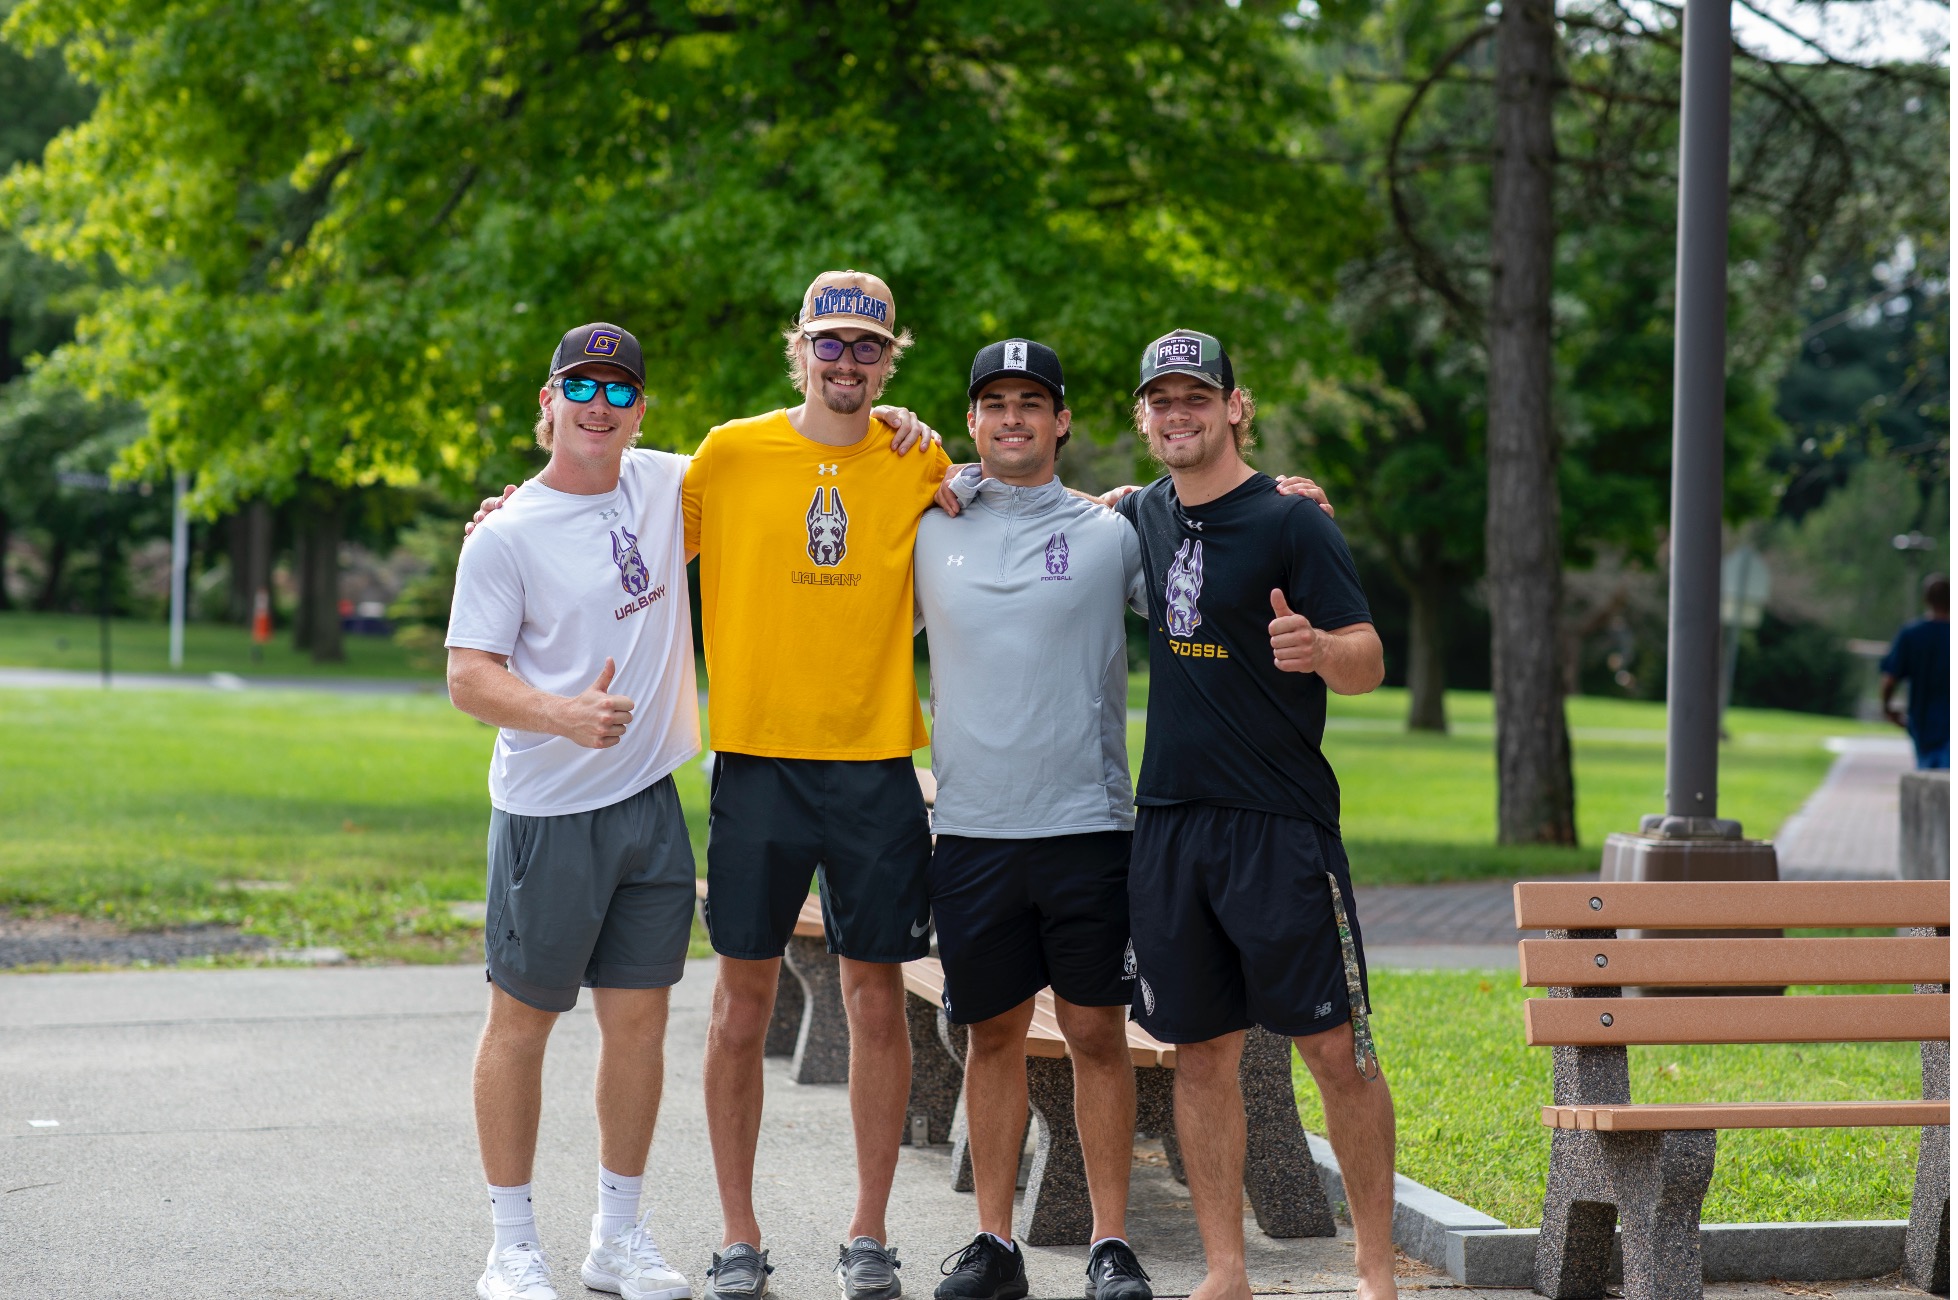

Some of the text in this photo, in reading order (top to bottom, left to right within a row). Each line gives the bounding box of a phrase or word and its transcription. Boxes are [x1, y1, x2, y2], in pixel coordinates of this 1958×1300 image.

[814, 294, 853, 317] MAPLE
[854, 295, 888, 323] LEAFS
[1159, 343, 1198, 358] FRED'S
[791, 571, 862, 587] UALBANY
[614, 584, 666, 621] UALBANY
[1159, 627, 1229, 659] ROSSE
